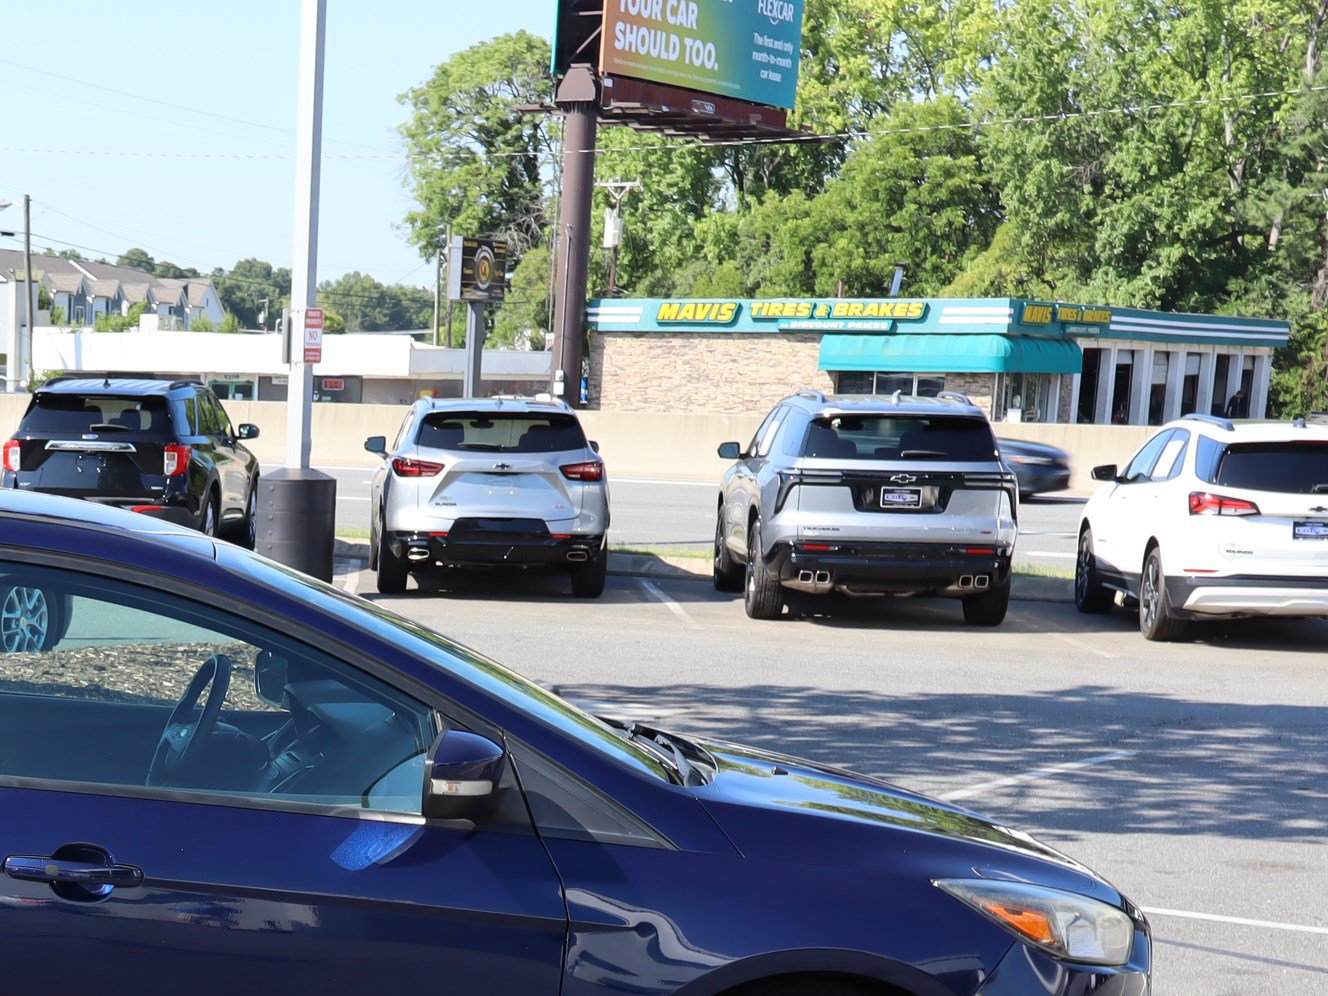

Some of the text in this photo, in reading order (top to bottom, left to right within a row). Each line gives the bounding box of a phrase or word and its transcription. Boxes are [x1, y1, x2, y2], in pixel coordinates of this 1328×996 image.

[666, 0, 698, 30] CAR
[757, 0, 794, 22] FLEXCAR
[614, 20, 719, 71] SHOULD TOO.
[753, 32, 793, 55] The first and only
[752, 51, 792, 69] month-to-month
[759, 69, 782, 82] car lease
[657, 302, 923, 321] MAVIS TIRES & BRAKES
[1023, 305, 1053, 323] MAVIS
[1057, 307, 1078, 320] TIRES
[1083, 309, 1111, 323] BRAKES
[789, 321, 845, 330] DISCOUNT
[847, 321, 888, 330] PRICES
[308, 330, 318, 341] NO
